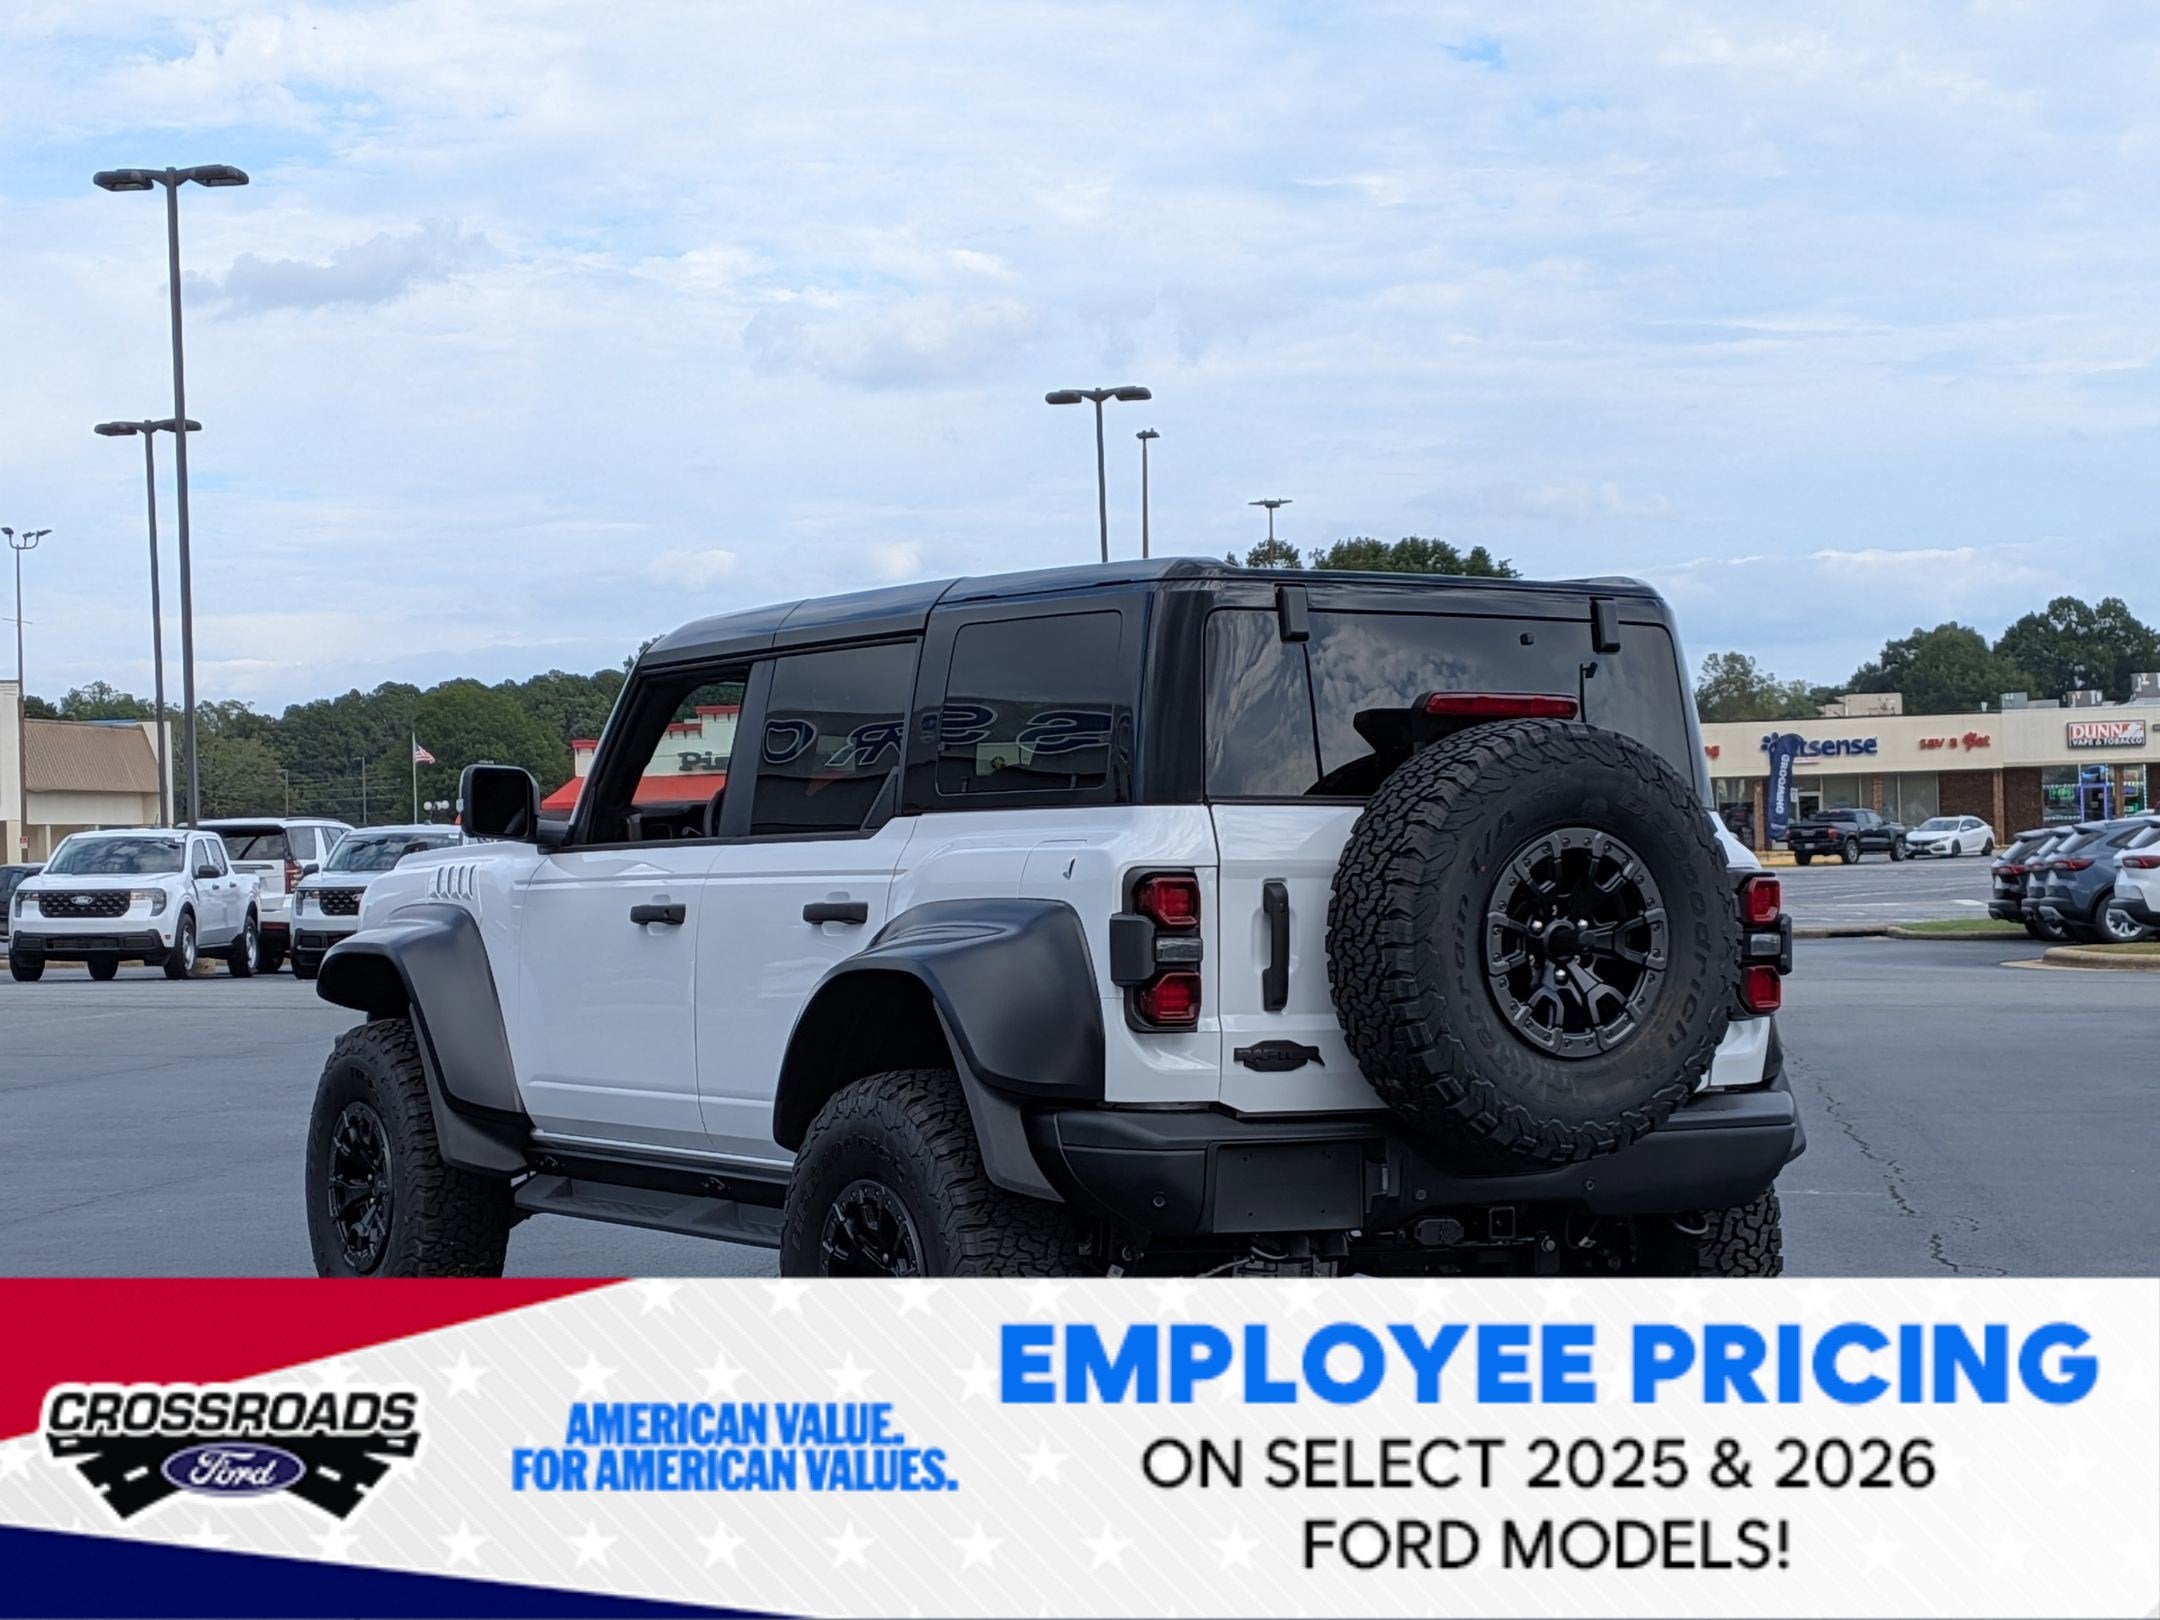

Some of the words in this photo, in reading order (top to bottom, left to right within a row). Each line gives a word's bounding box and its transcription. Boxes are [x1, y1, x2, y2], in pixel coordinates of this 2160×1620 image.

[2072, 724, 2124, 739] DUNN
[2103, 736, 2143, 745] TOBACCO
[1770, 736, 1878, 757] tsense
[1775, 754, 1790, 814] GROOMING
